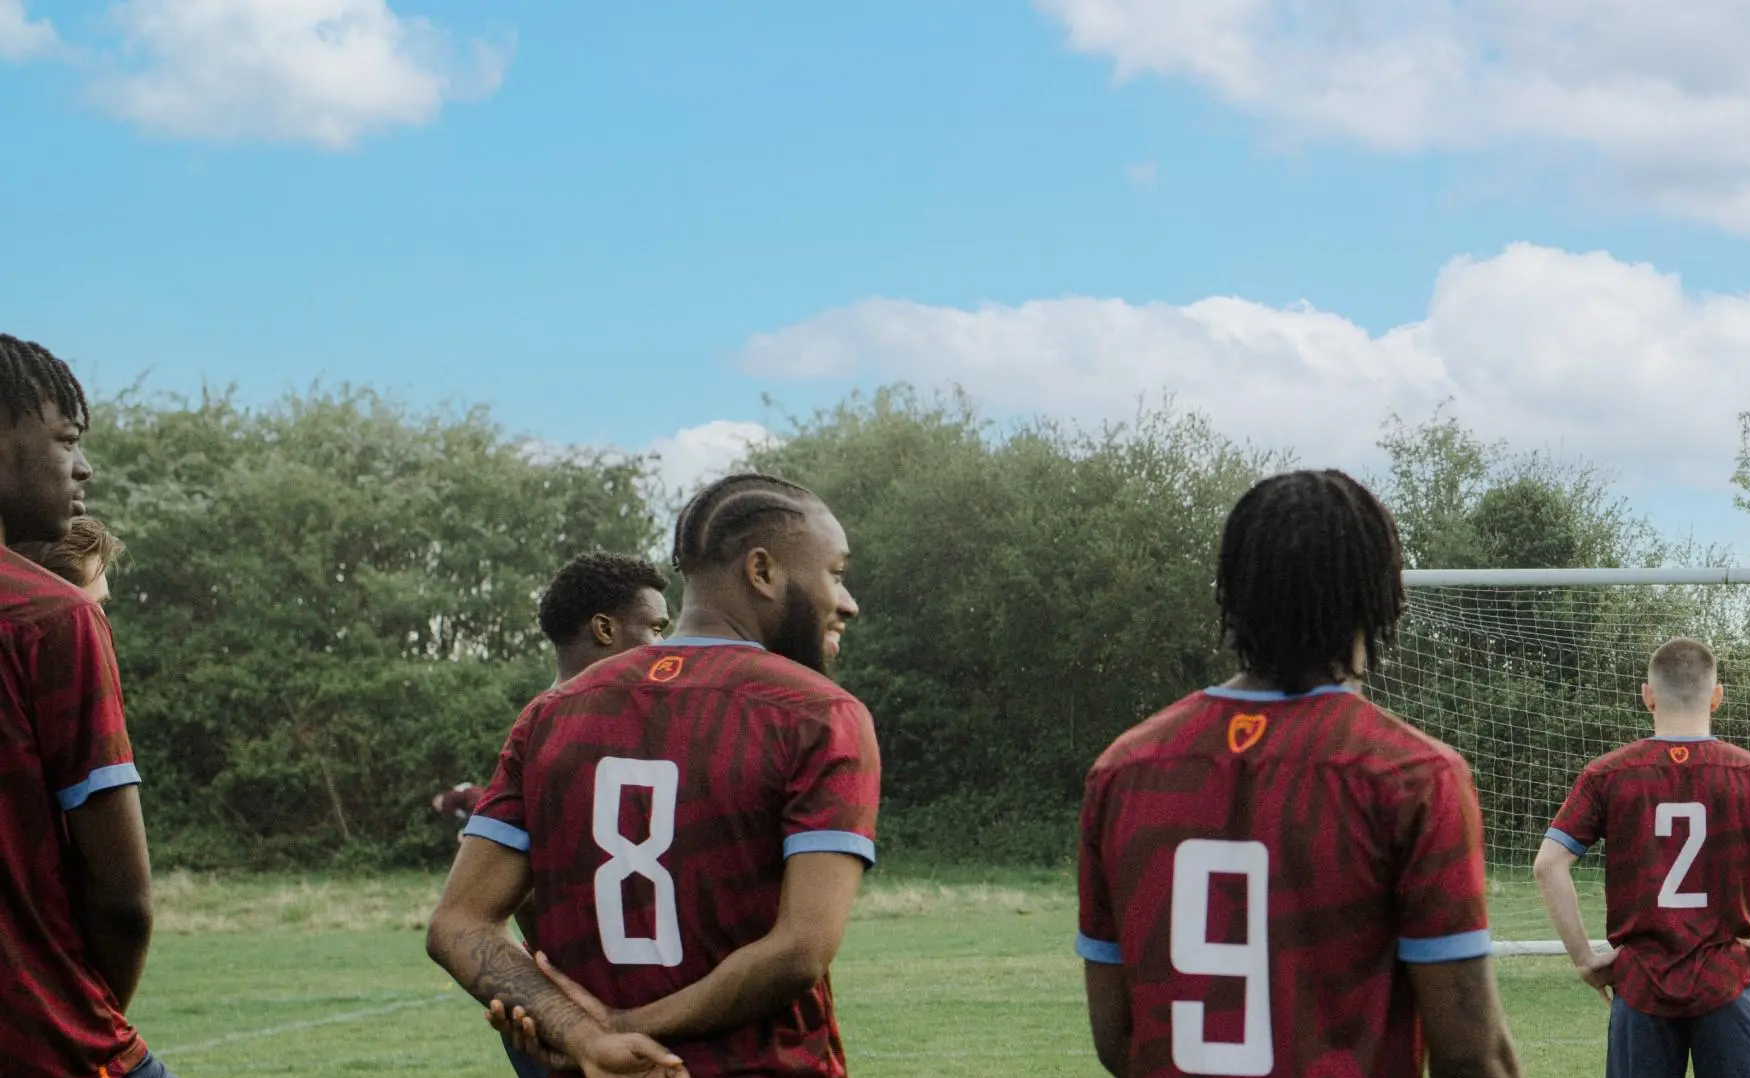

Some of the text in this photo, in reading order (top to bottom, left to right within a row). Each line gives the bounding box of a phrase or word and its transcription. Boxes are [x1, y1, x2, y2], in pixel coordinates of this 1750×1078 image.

[592, 756, 684, 968] 8
[1170, 838, 1274, 1077] 9
[1654, 801, 1708, 909] 2
